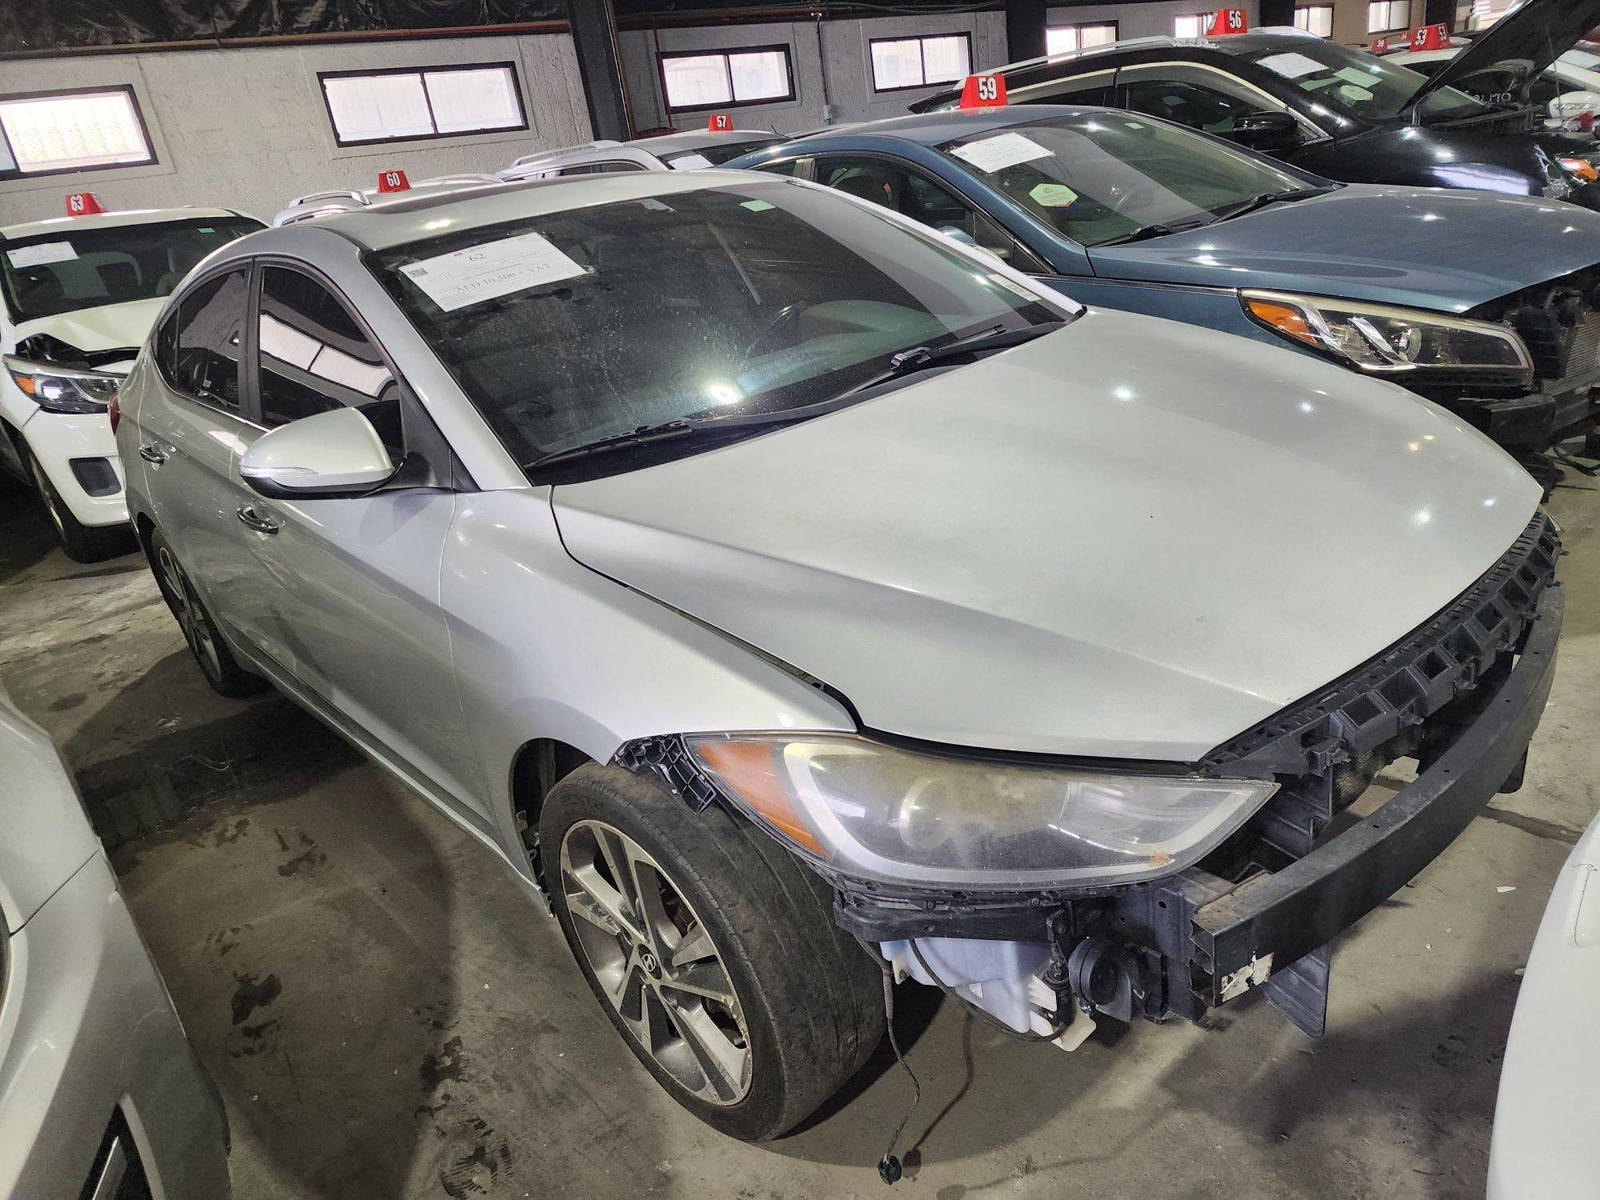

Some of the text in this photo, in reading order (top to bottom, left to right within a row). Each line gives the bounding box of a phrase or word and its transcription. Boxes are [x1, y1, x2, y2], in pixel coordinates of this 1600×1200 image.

[1229, 10, 1242, 29] 56
[1415, 29, 1428, 46] 53
[978, 77, 997, 100] 59
[716, 115, 727, 128] 57
[386, 172, 400, 187] 60
[70, 195, 84, 211] 63
